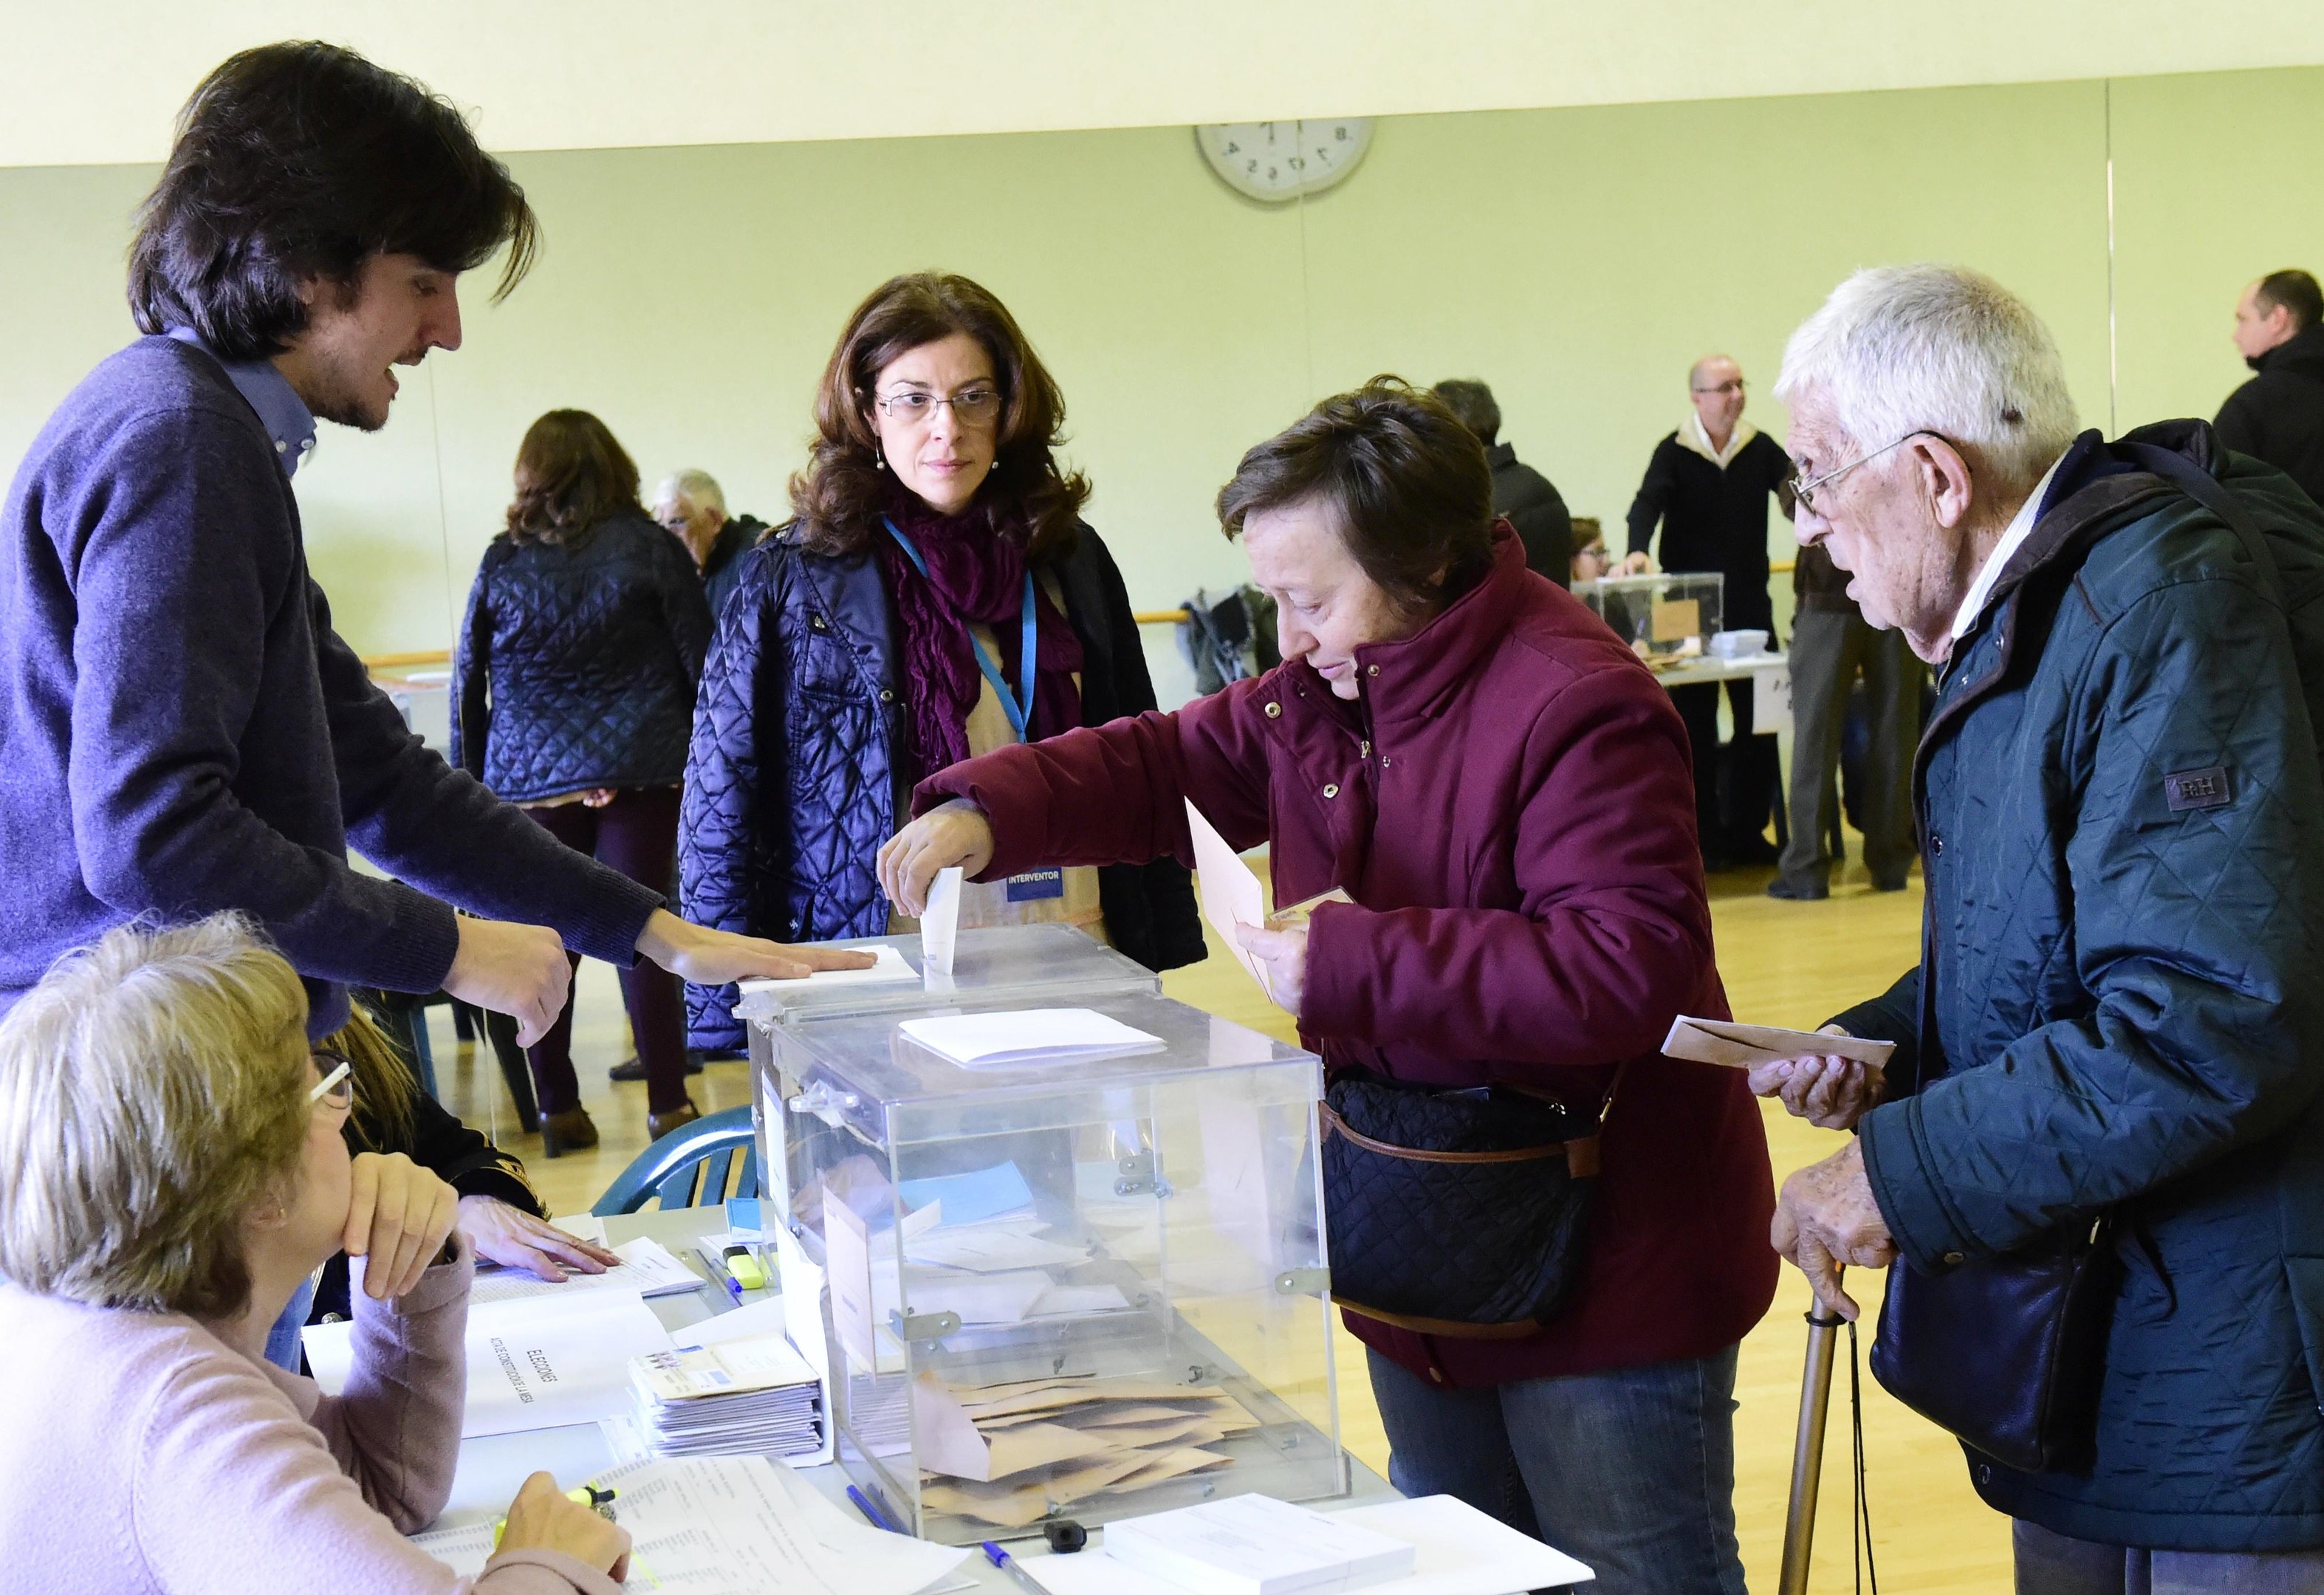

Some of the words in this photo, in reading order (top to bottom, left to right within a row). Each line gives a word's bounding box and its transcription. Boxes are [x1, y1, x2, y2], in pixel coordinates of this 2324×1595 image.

[1008, 871, 1059, 885] INTERVENTOR
[527, 1349, 558, 1383] ELECCIONES
[518, 1392, 535, 1404] MESA
